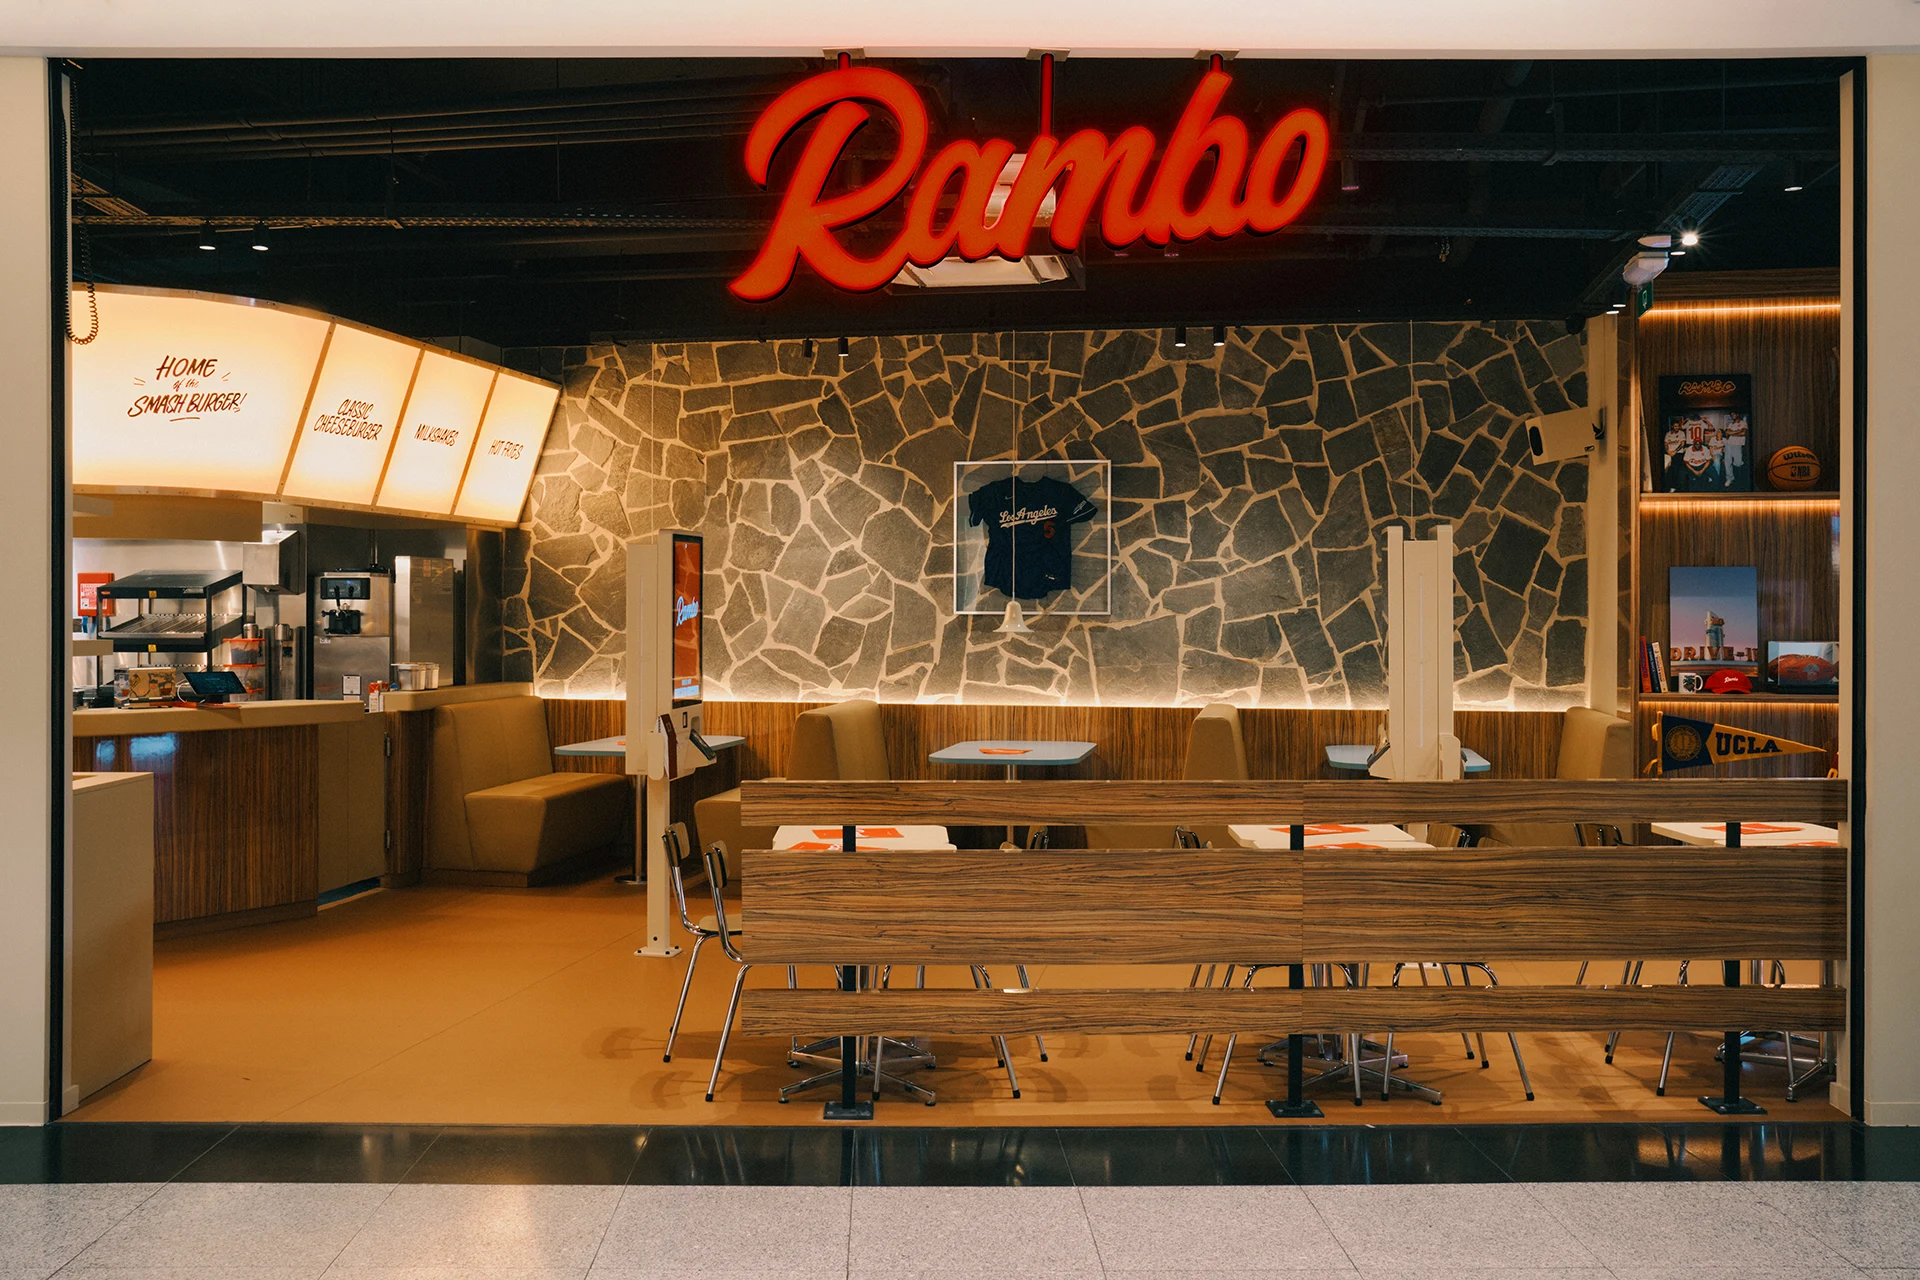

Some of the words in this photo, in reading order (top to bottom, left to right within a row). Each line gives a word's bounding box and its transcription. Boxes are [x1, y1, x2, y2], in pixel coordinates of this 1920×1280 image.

[727, 66, 1330, 303] Rambo
[156, 355, 218, 380] HOME
[173, 378, 185, 392] of
[185, 379, 199, 388] the
[127, 393, 188, 417] SMASH
[186, 392, 247, 413] BURGER!
[337, 398, 374, 420] CLASSIC
[313, 414, 383, 441] CHEESEBURGER
[414, 423, 459, 447] MILKSHAKES
[488, 439, 505, 456] HOT
[500, 441, 524, 460] FRIES
[1797, 466, 1810, 477] NBA
[999, 510, 1016, 523] Los
[1016, 505, 1058, 526] Angeles
[1043, 521, 1055, 539] 5
[1715, 731, 1783, 757] UCLA
